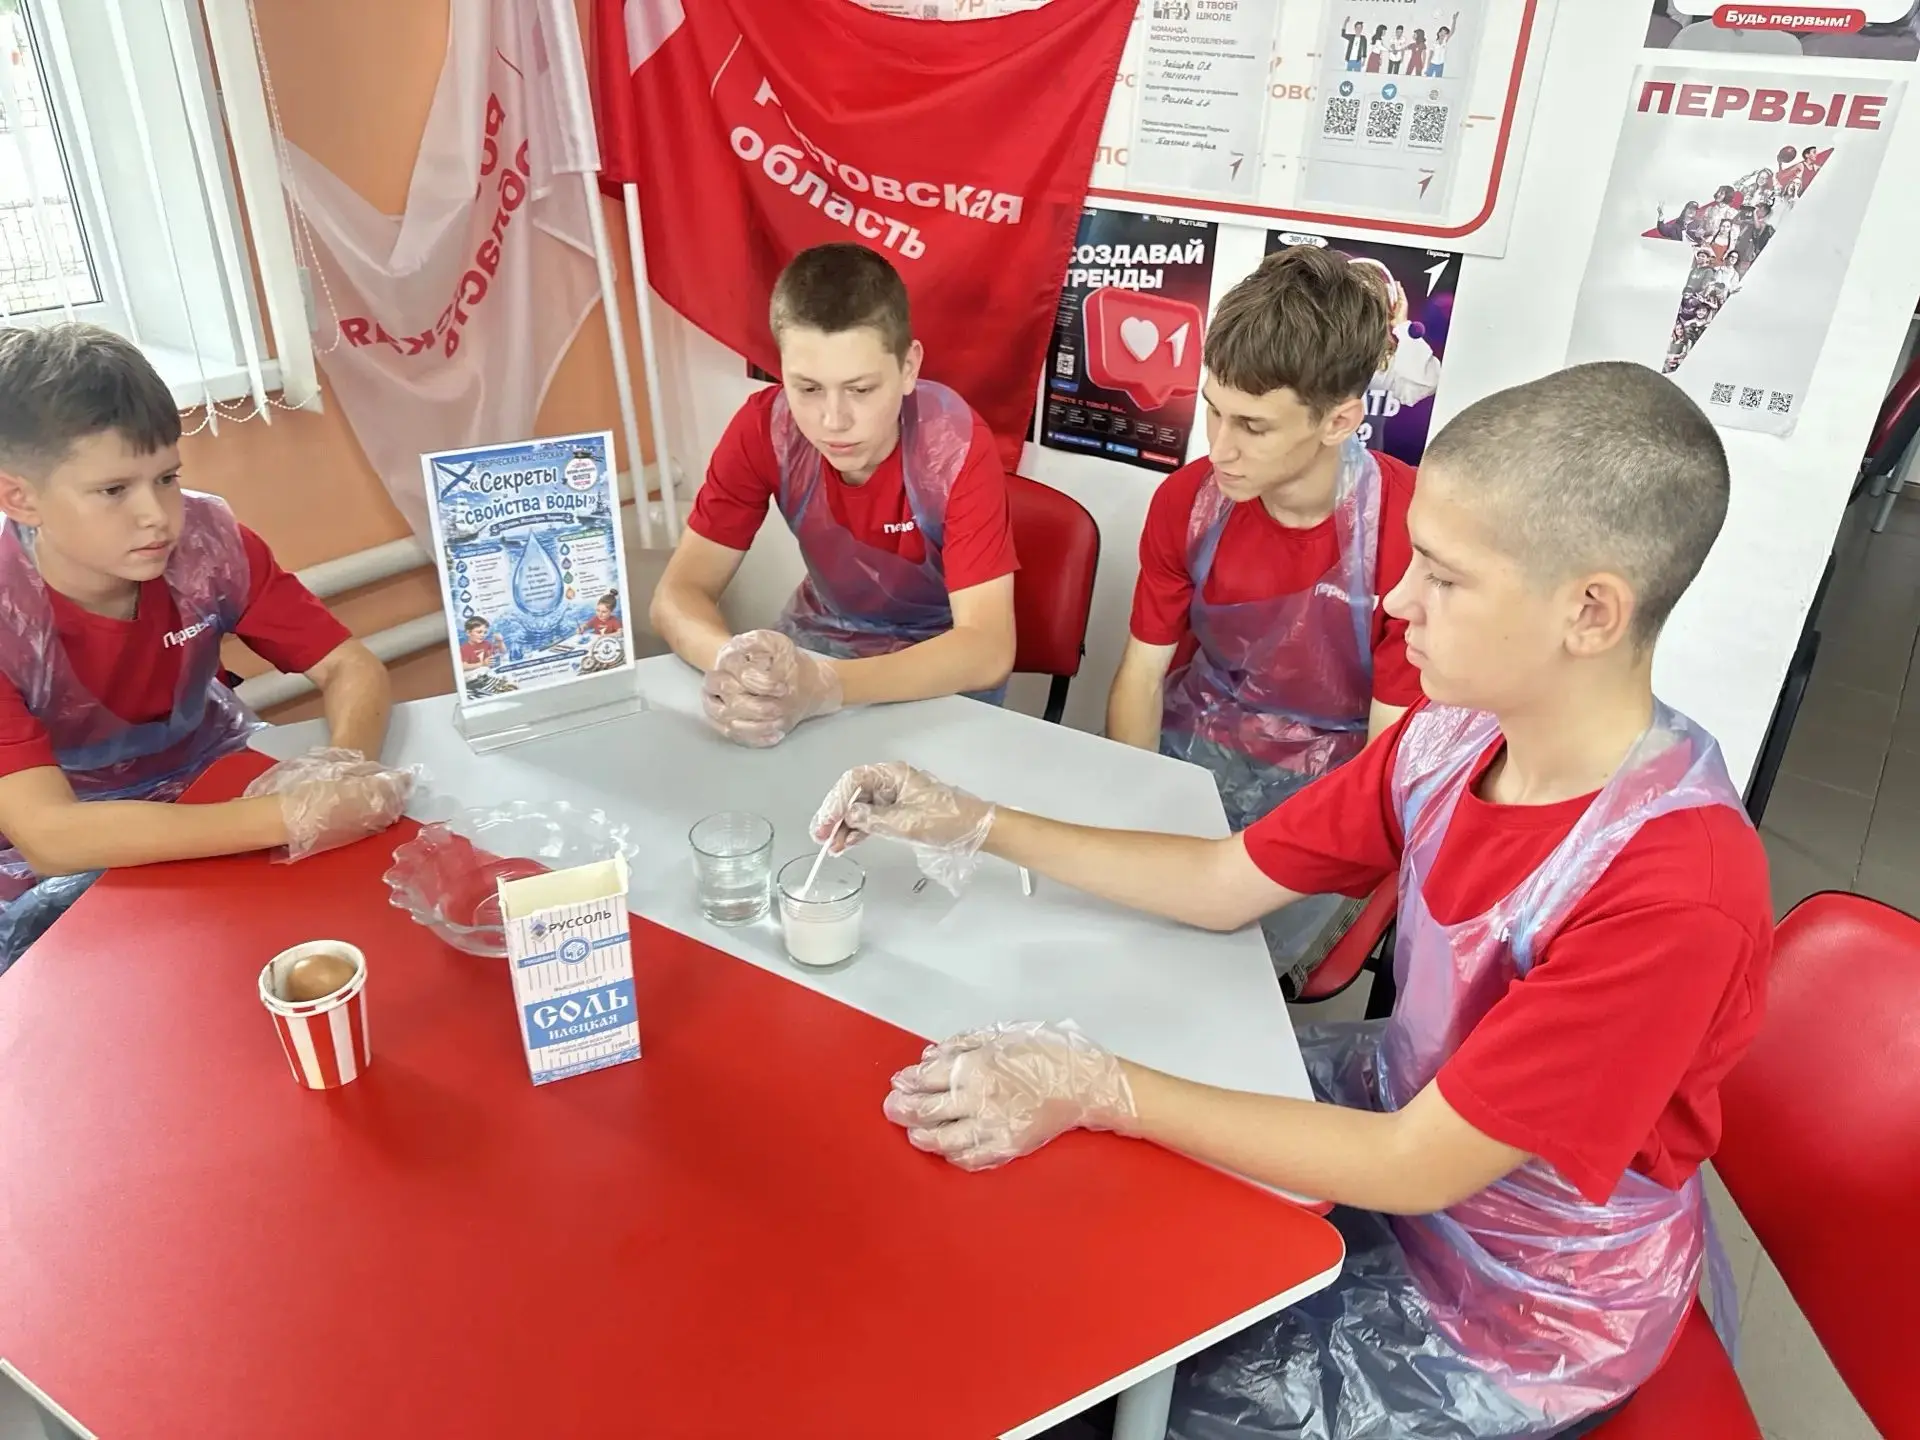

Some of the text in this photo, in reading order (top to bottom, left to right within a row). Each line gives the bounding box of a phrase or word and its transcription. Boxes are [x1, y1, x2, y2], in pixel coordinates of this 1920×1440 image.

[1196, 12, 1232, 21] ШКОЛЕ
[1725, 10, 1852, 28] Будь первым!
[1150, 35, 1190, 43] МЕСТНОГО
[1151, 25, 1188, 34] КОМАНДА
[1637, 81, 1888, 130] ПЕРВЫЕ
[729, 126, 926, 260] область
[1063, 268, 1164, 291] ТРЕНДЫ
[469, 468, 557, 493] «Секреты
[465, 497, 541, 526] свойства
[546, 493, 596, 511] воды»
[549, 910, 612, 933] РУССОЛЬ
[533, 988, 629, 1030] СОЛЬ
